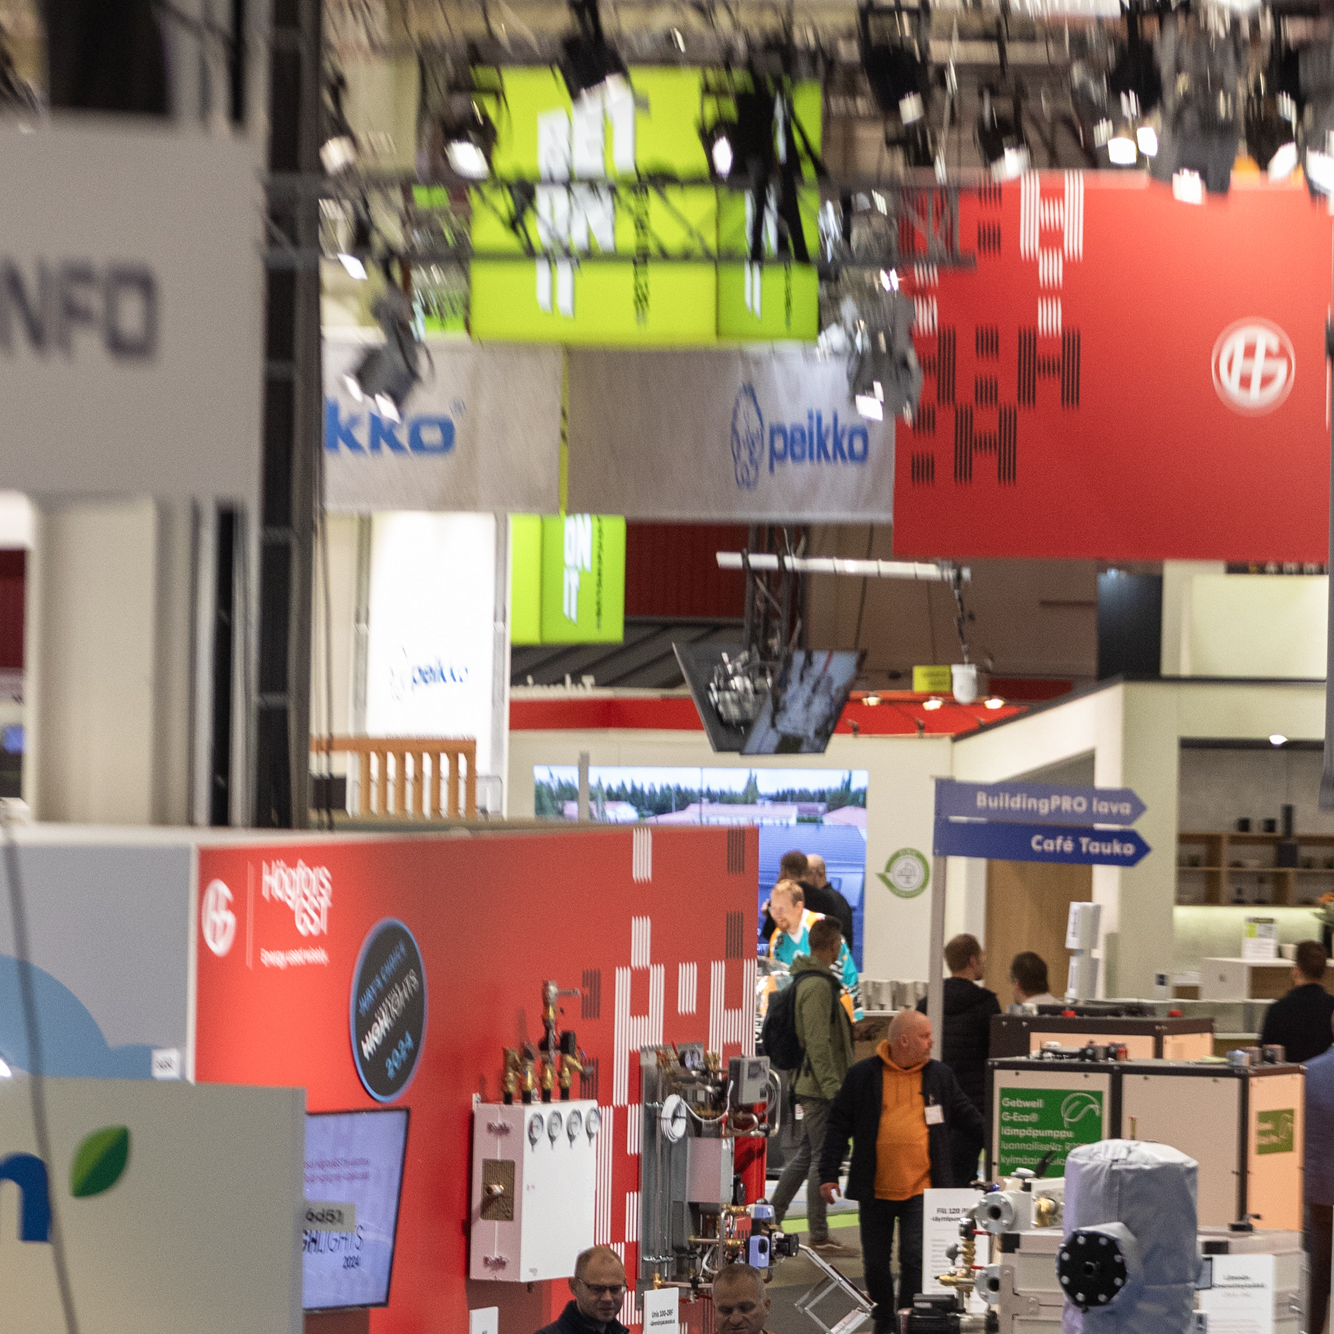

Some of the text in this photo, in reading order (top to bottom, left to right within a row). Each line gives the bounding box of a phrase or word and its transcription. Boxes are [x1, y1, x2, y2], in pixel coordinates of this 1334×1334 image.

[768, 409, 869, 474] peikko
[975, 791, 1088, 816] BuildingPRO
[1030, 834, 1136, 857] Café Tauko
